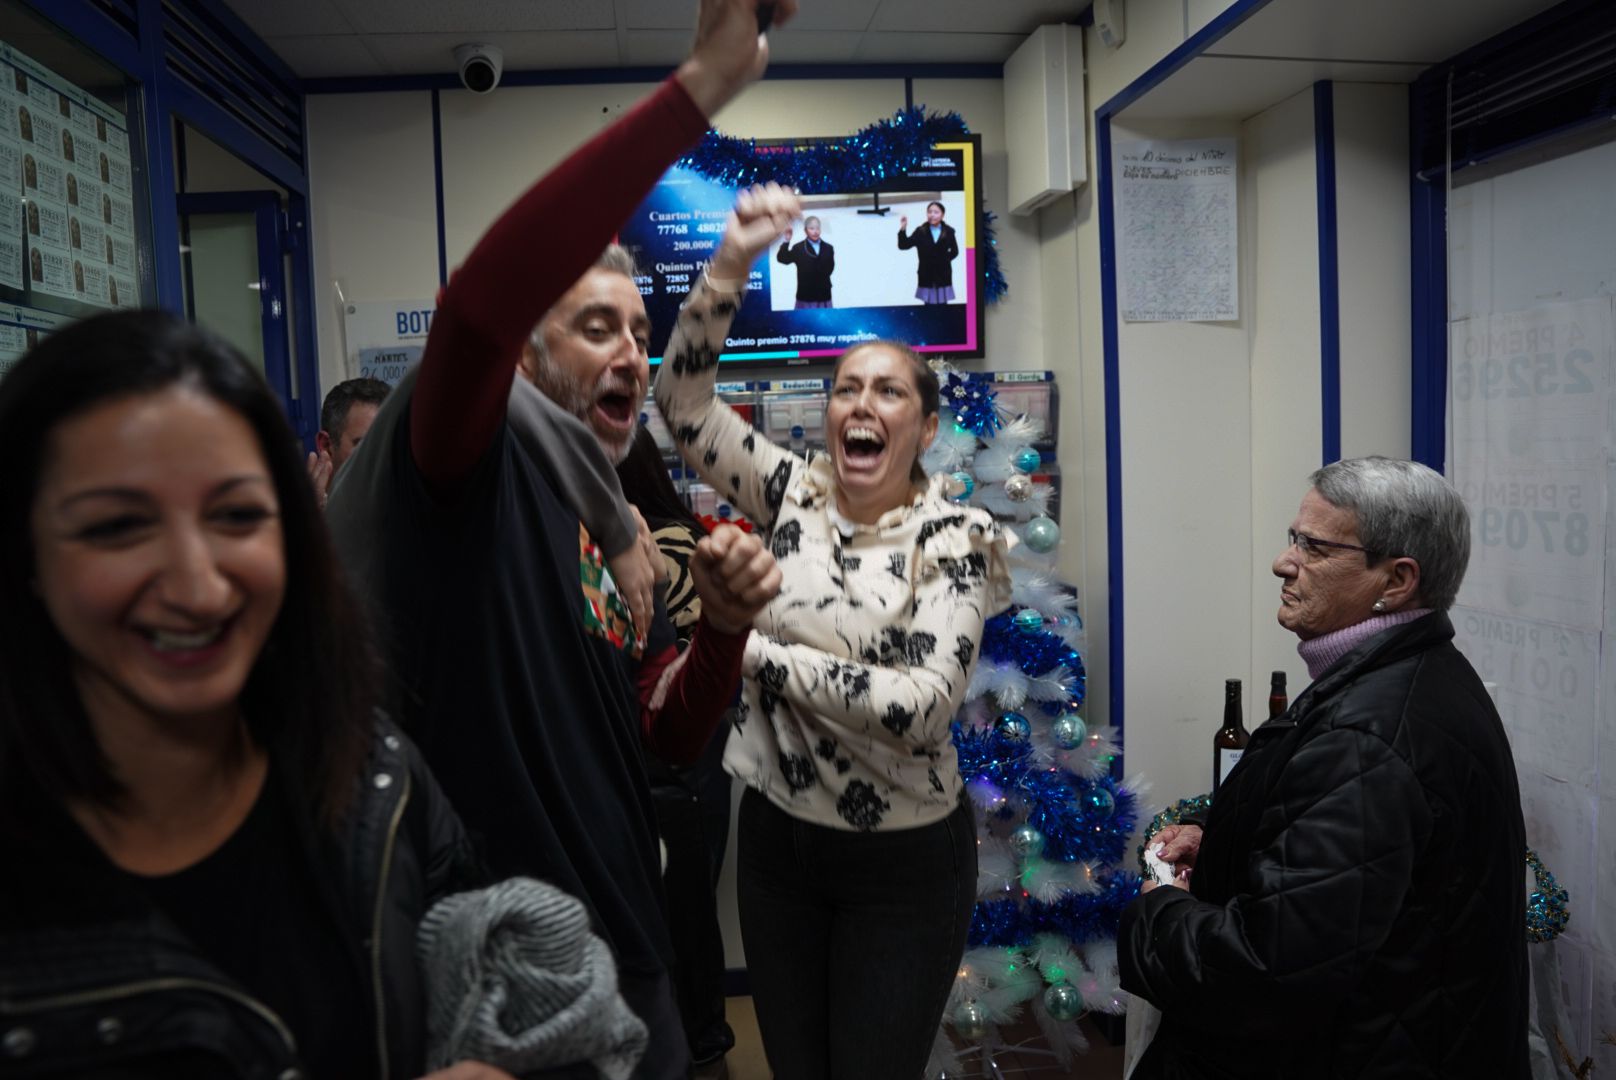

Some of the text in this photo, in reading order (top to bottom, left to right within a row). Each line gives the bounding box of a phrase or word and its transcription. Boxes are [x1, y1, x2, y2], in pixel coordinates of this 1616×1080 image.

[649, 208, 729, 222] Cuartos Premi
[657, 224, 688, 235] 77768
[656, 261, 694, 274] Quintos
[665, 274, 689, 283] 72853
[666, 285, 690, 294] 97345
[725, 337, 756, 347] Quinto
[757, 336, 788, 347] premio
[790, 335, 815, 344] 37876
[817, 334, 836, 344] muy
